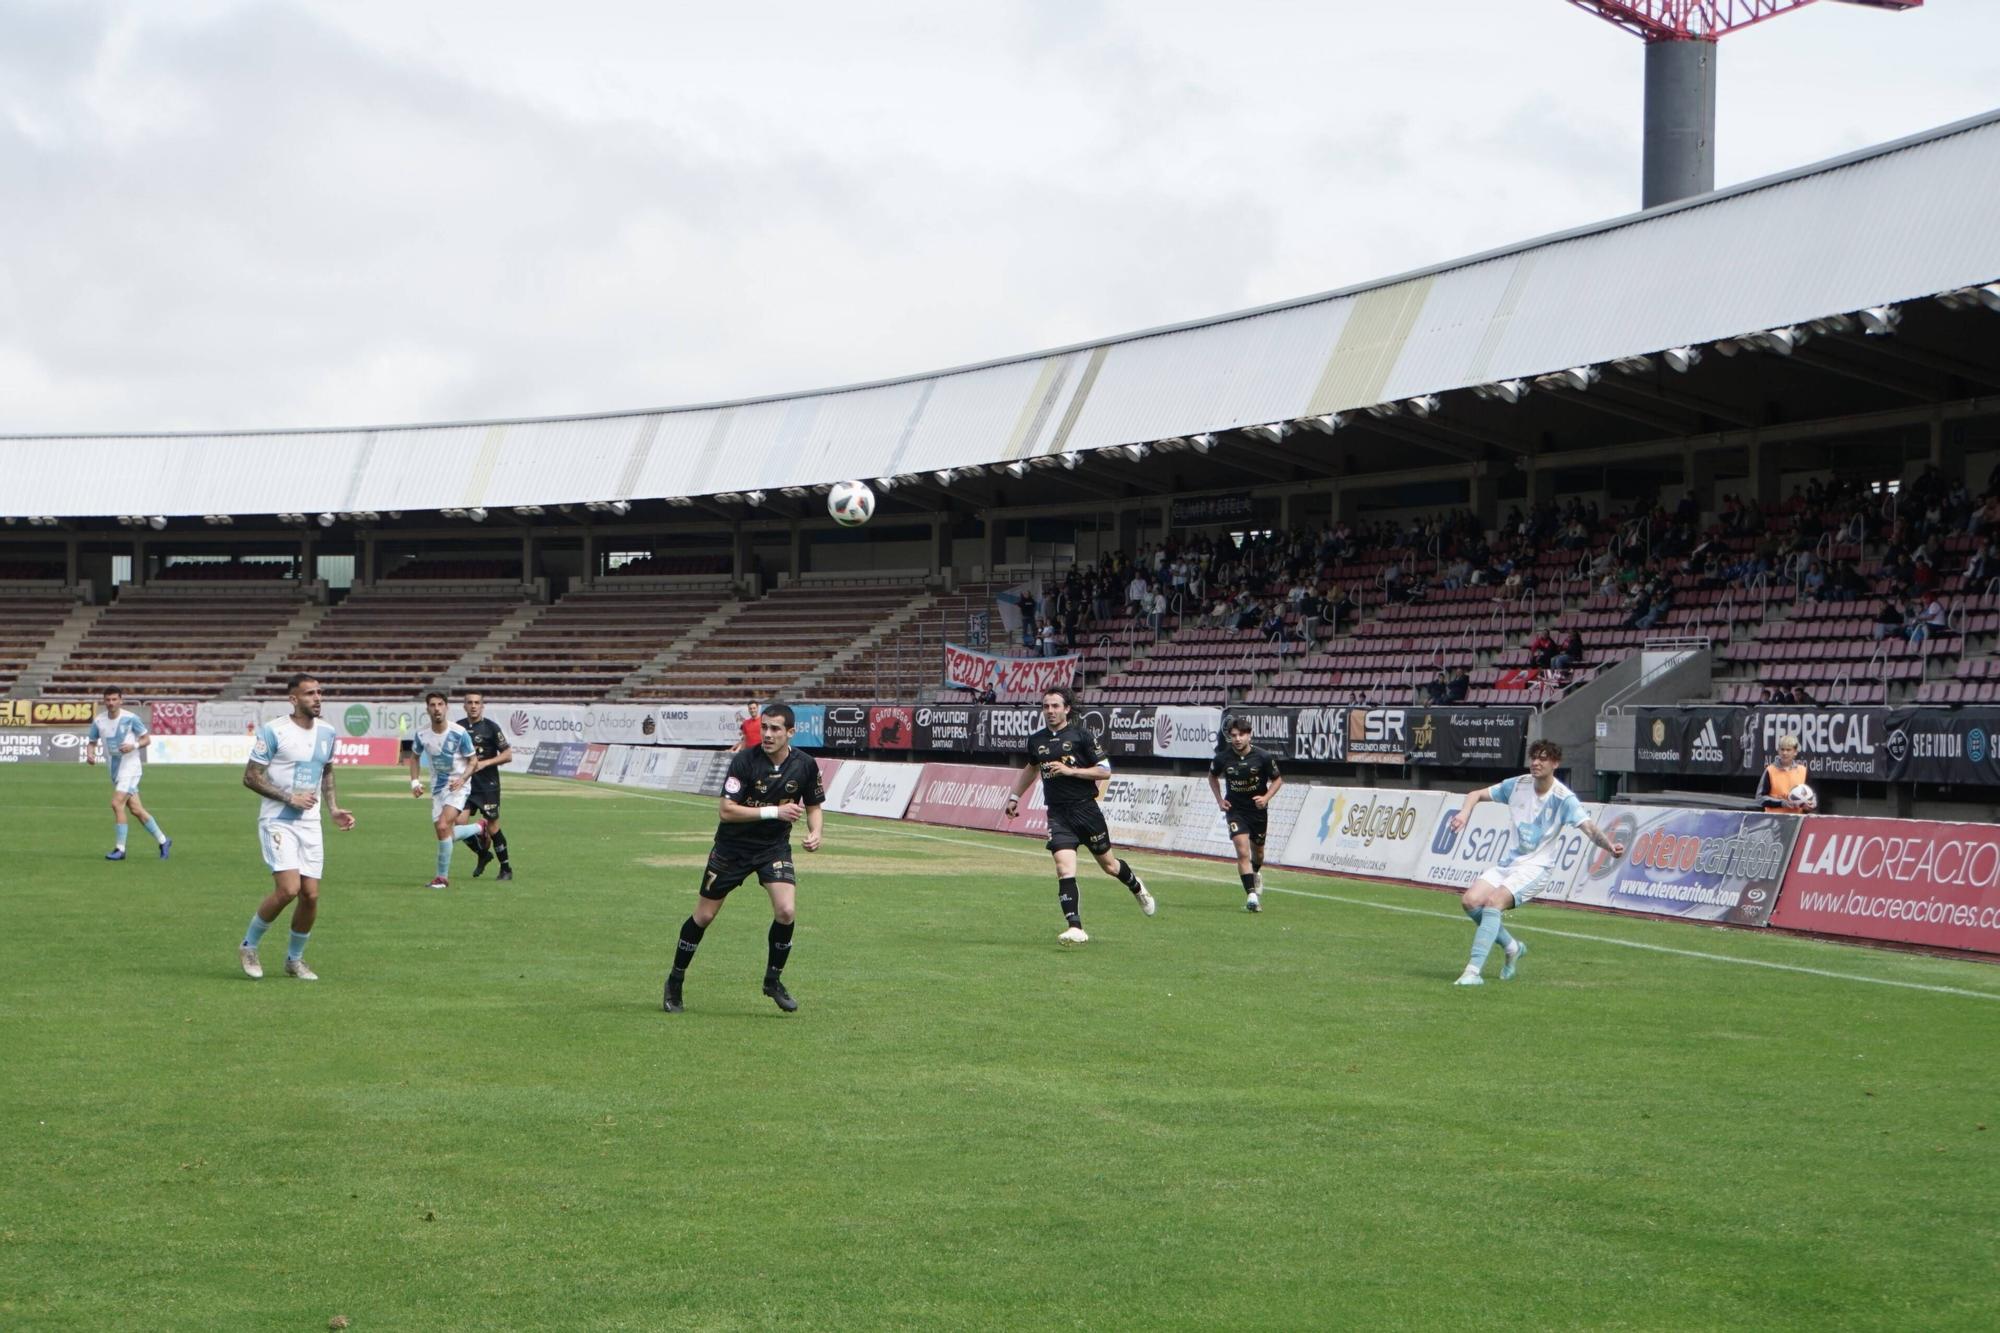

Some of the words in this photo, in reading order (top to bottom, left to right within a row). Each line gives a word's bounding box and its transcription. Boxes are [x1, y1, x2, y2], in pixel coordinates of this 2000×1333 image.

[34, 703, 92, 720] GADIS
[599, 711, 636, 728] Afiador
[661, 711, 688, 720] VAMOS
[932, 711, 969, 724] HYUNDAI
[1109, 708, 1130, 729] Fuco
[1131, 710, 1155, 729] Lois
[932, 726, 968, 739] HYUPERSA
[990, 711, 1047, 736] FERRECA
[1364, 710, 1405, 740] SR
[1763, 713, 1875, 754] FERRECAL
[335, 740, 370, 756] hou
[1379, 744, 1391, 752] REY
[1912, 733, 1962, 757] SEGUNDA
[1809, 757, 1823, 771] del
[1825, 757, 1875, 773] Profesional
[925, 780, 966, 807] CONCELLO
[1342, 794, 1417, 847] salgado
[706, 870, 717, 891] 7
[1618, 878, 1740, 907] www.oterocariton.com
